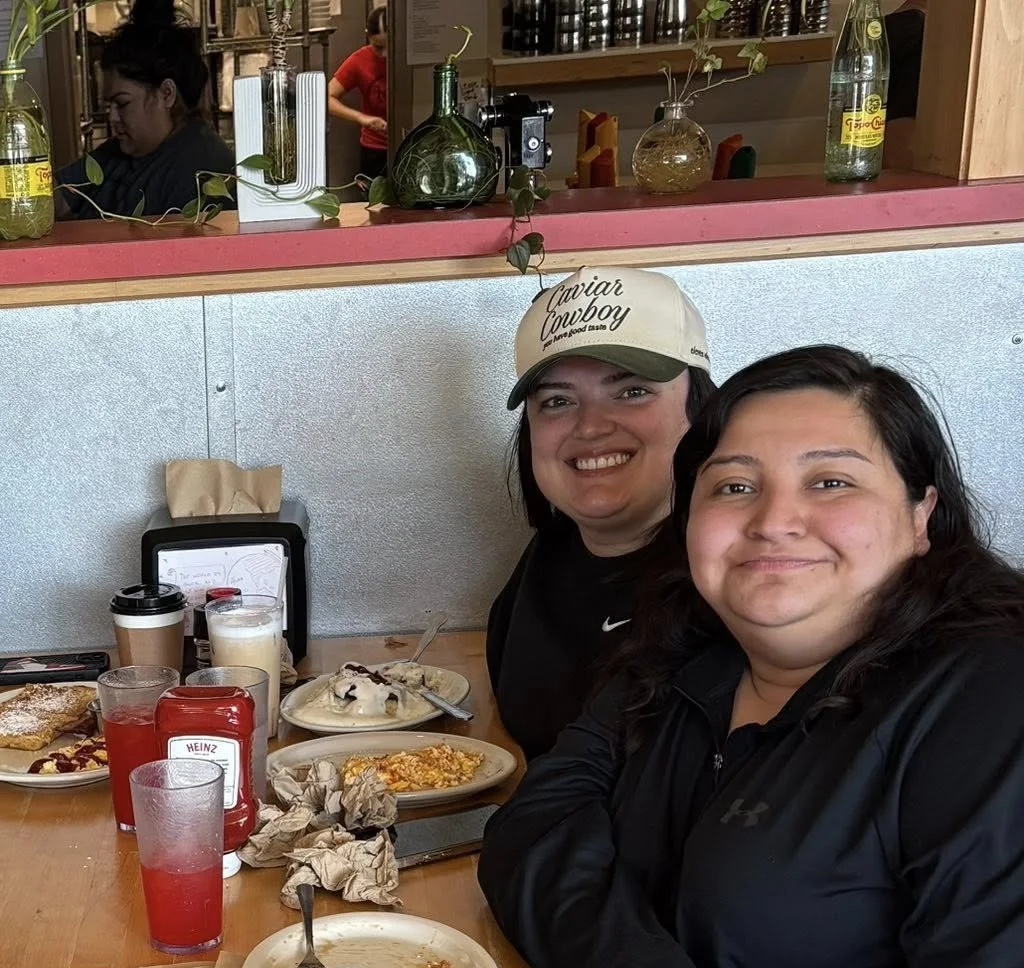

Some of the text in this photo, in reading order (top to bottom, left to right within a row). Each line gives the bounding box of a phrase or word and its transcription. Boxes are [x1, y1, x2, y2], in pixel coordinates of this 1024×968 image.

[546, 275, 623, 312] Caviar
[540, 296, 631, 341] Cowboy
[568, 325, 587, 338] good
[588, 324, 607, 332] taste
[186, 742, 218, 754] HEINZ
